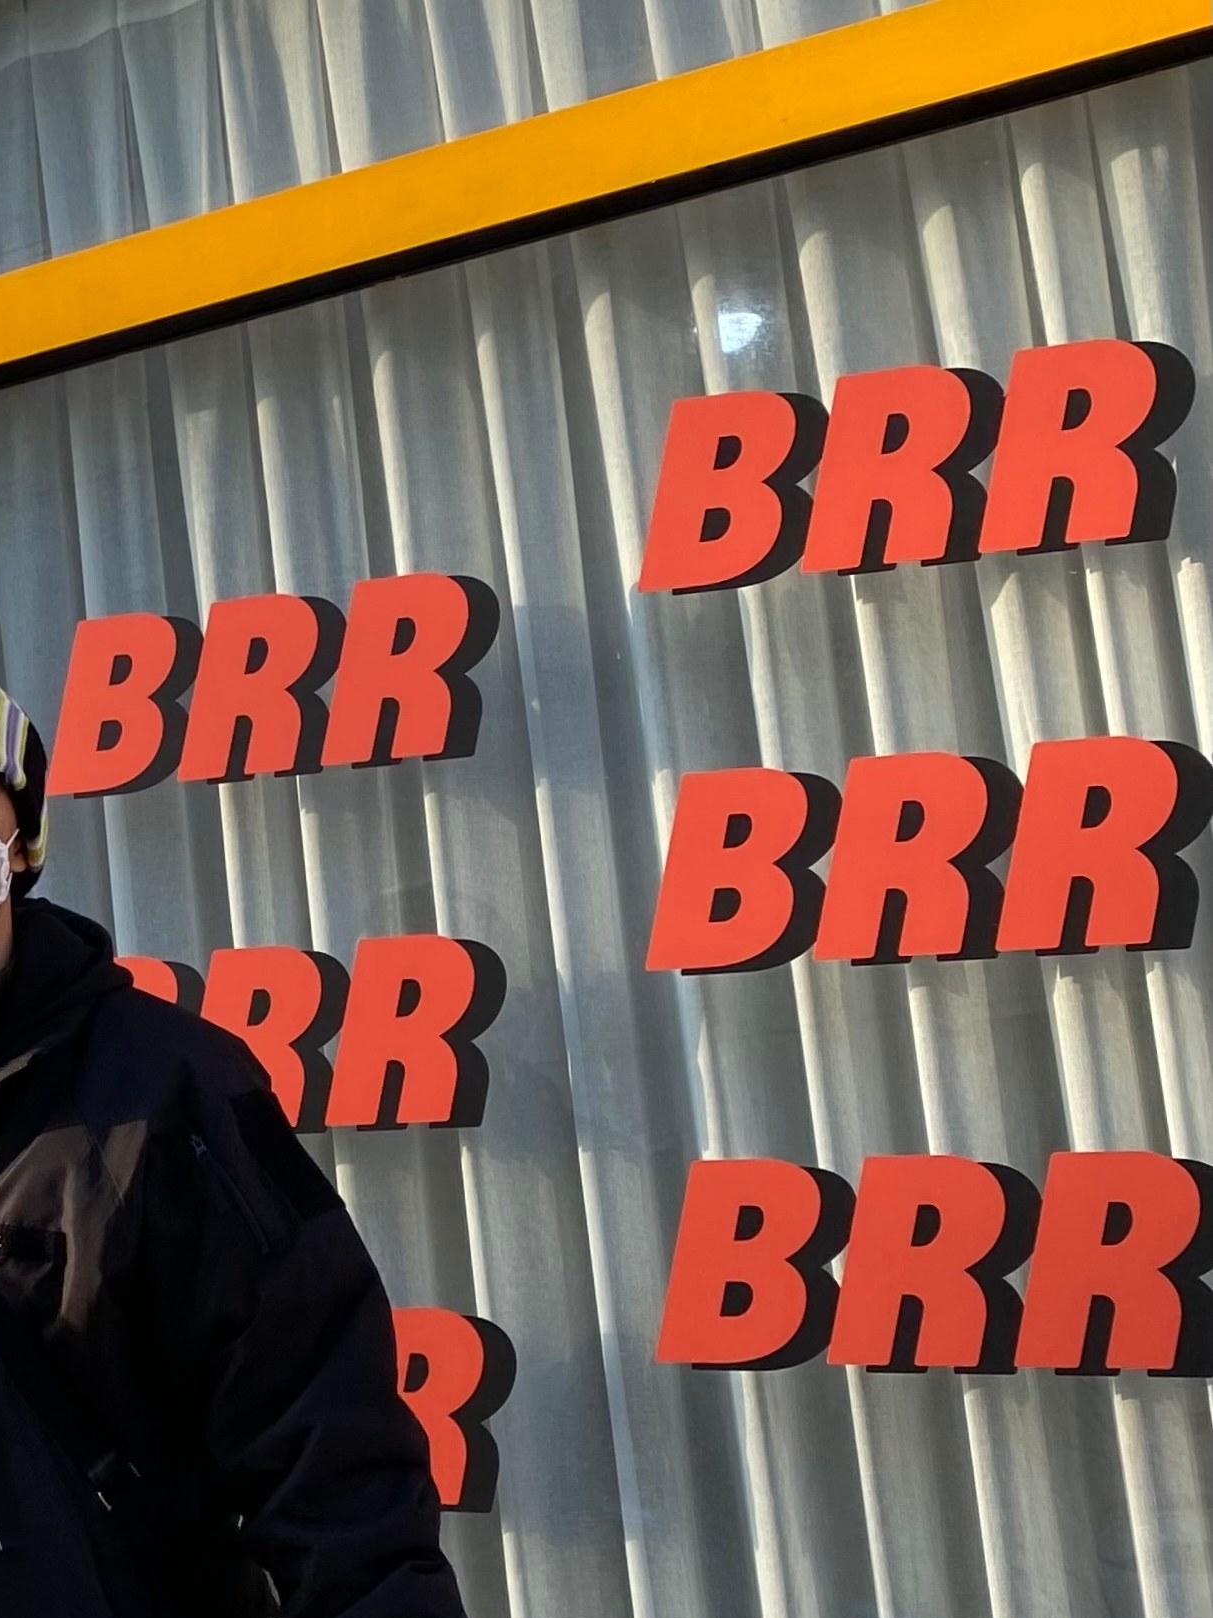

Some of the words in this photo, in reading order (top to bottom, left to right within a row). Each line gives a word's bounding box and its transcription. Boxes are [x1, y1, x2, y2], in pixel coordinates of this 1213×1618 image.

[636, 338, 1160, 594] BRR
[44, 571, 472, 798] BRR
[644, 734, 1180, 973] BRR
[114, 932, 478, 1129] RR
[654, 1149, 1202, 1372] BRR
